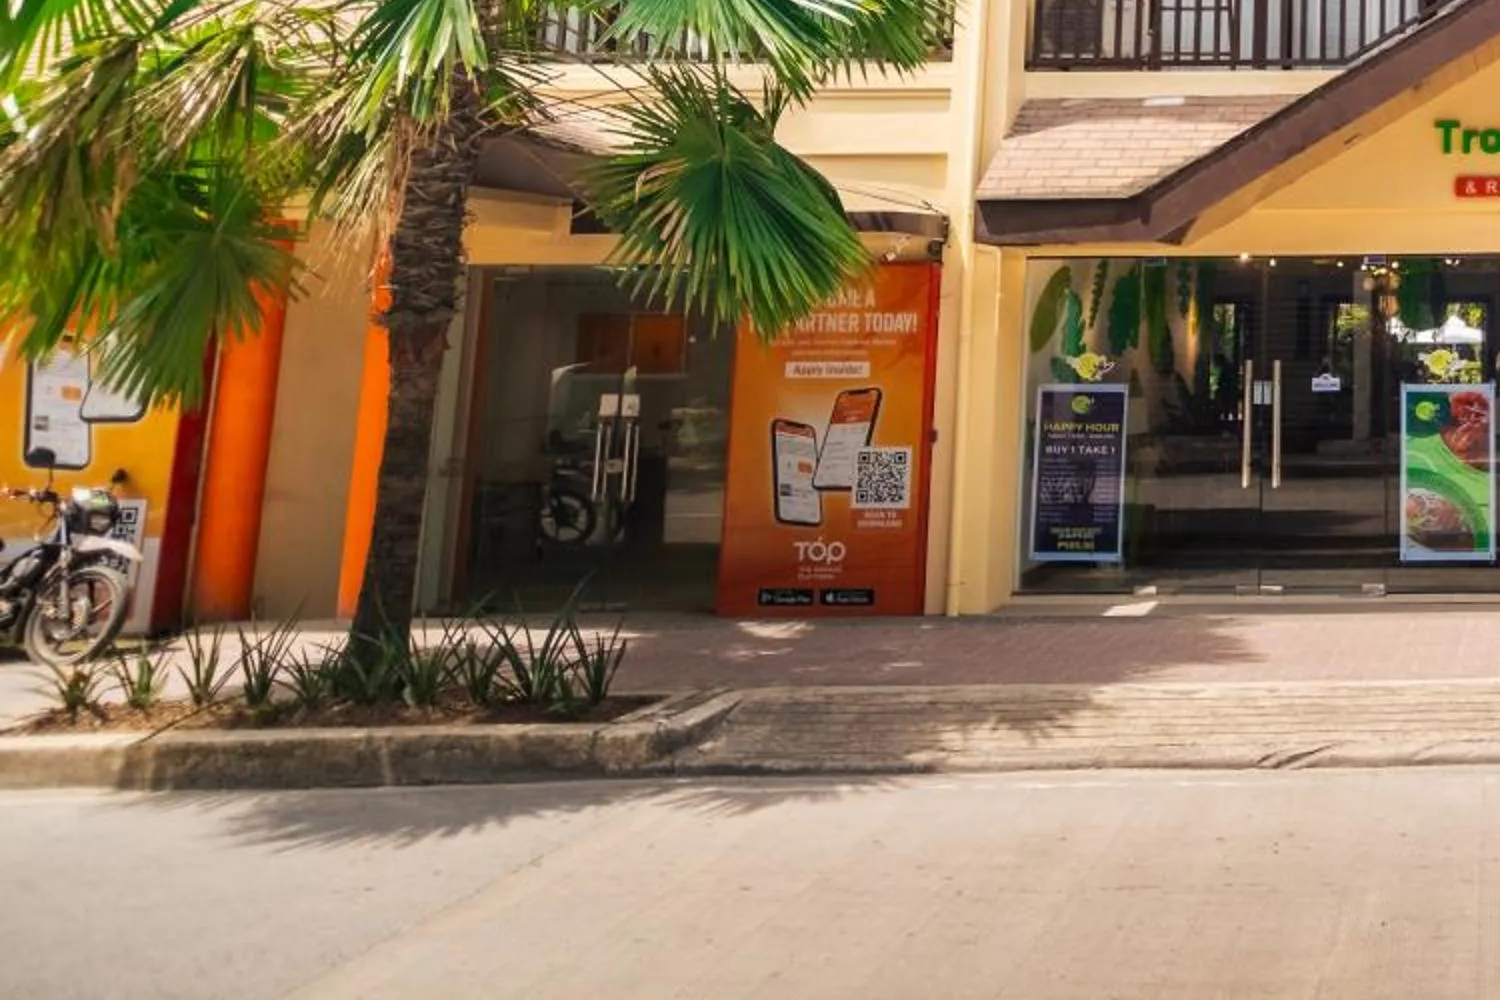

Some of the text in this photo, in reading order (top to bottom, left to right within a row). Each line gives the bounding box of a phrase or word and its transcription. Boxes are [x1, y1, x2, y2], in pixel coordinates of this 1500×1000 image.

[1465, 179, 1477, 194] &
[864, 289, 876, 307] A
[864, 312, 918, 333] TODAY!
[1043, 423, 1119, 432] HAPPY HOUR
[1045, 445, 1068, 454] BUY
[1078, 445, 1109, 454] TAKE
